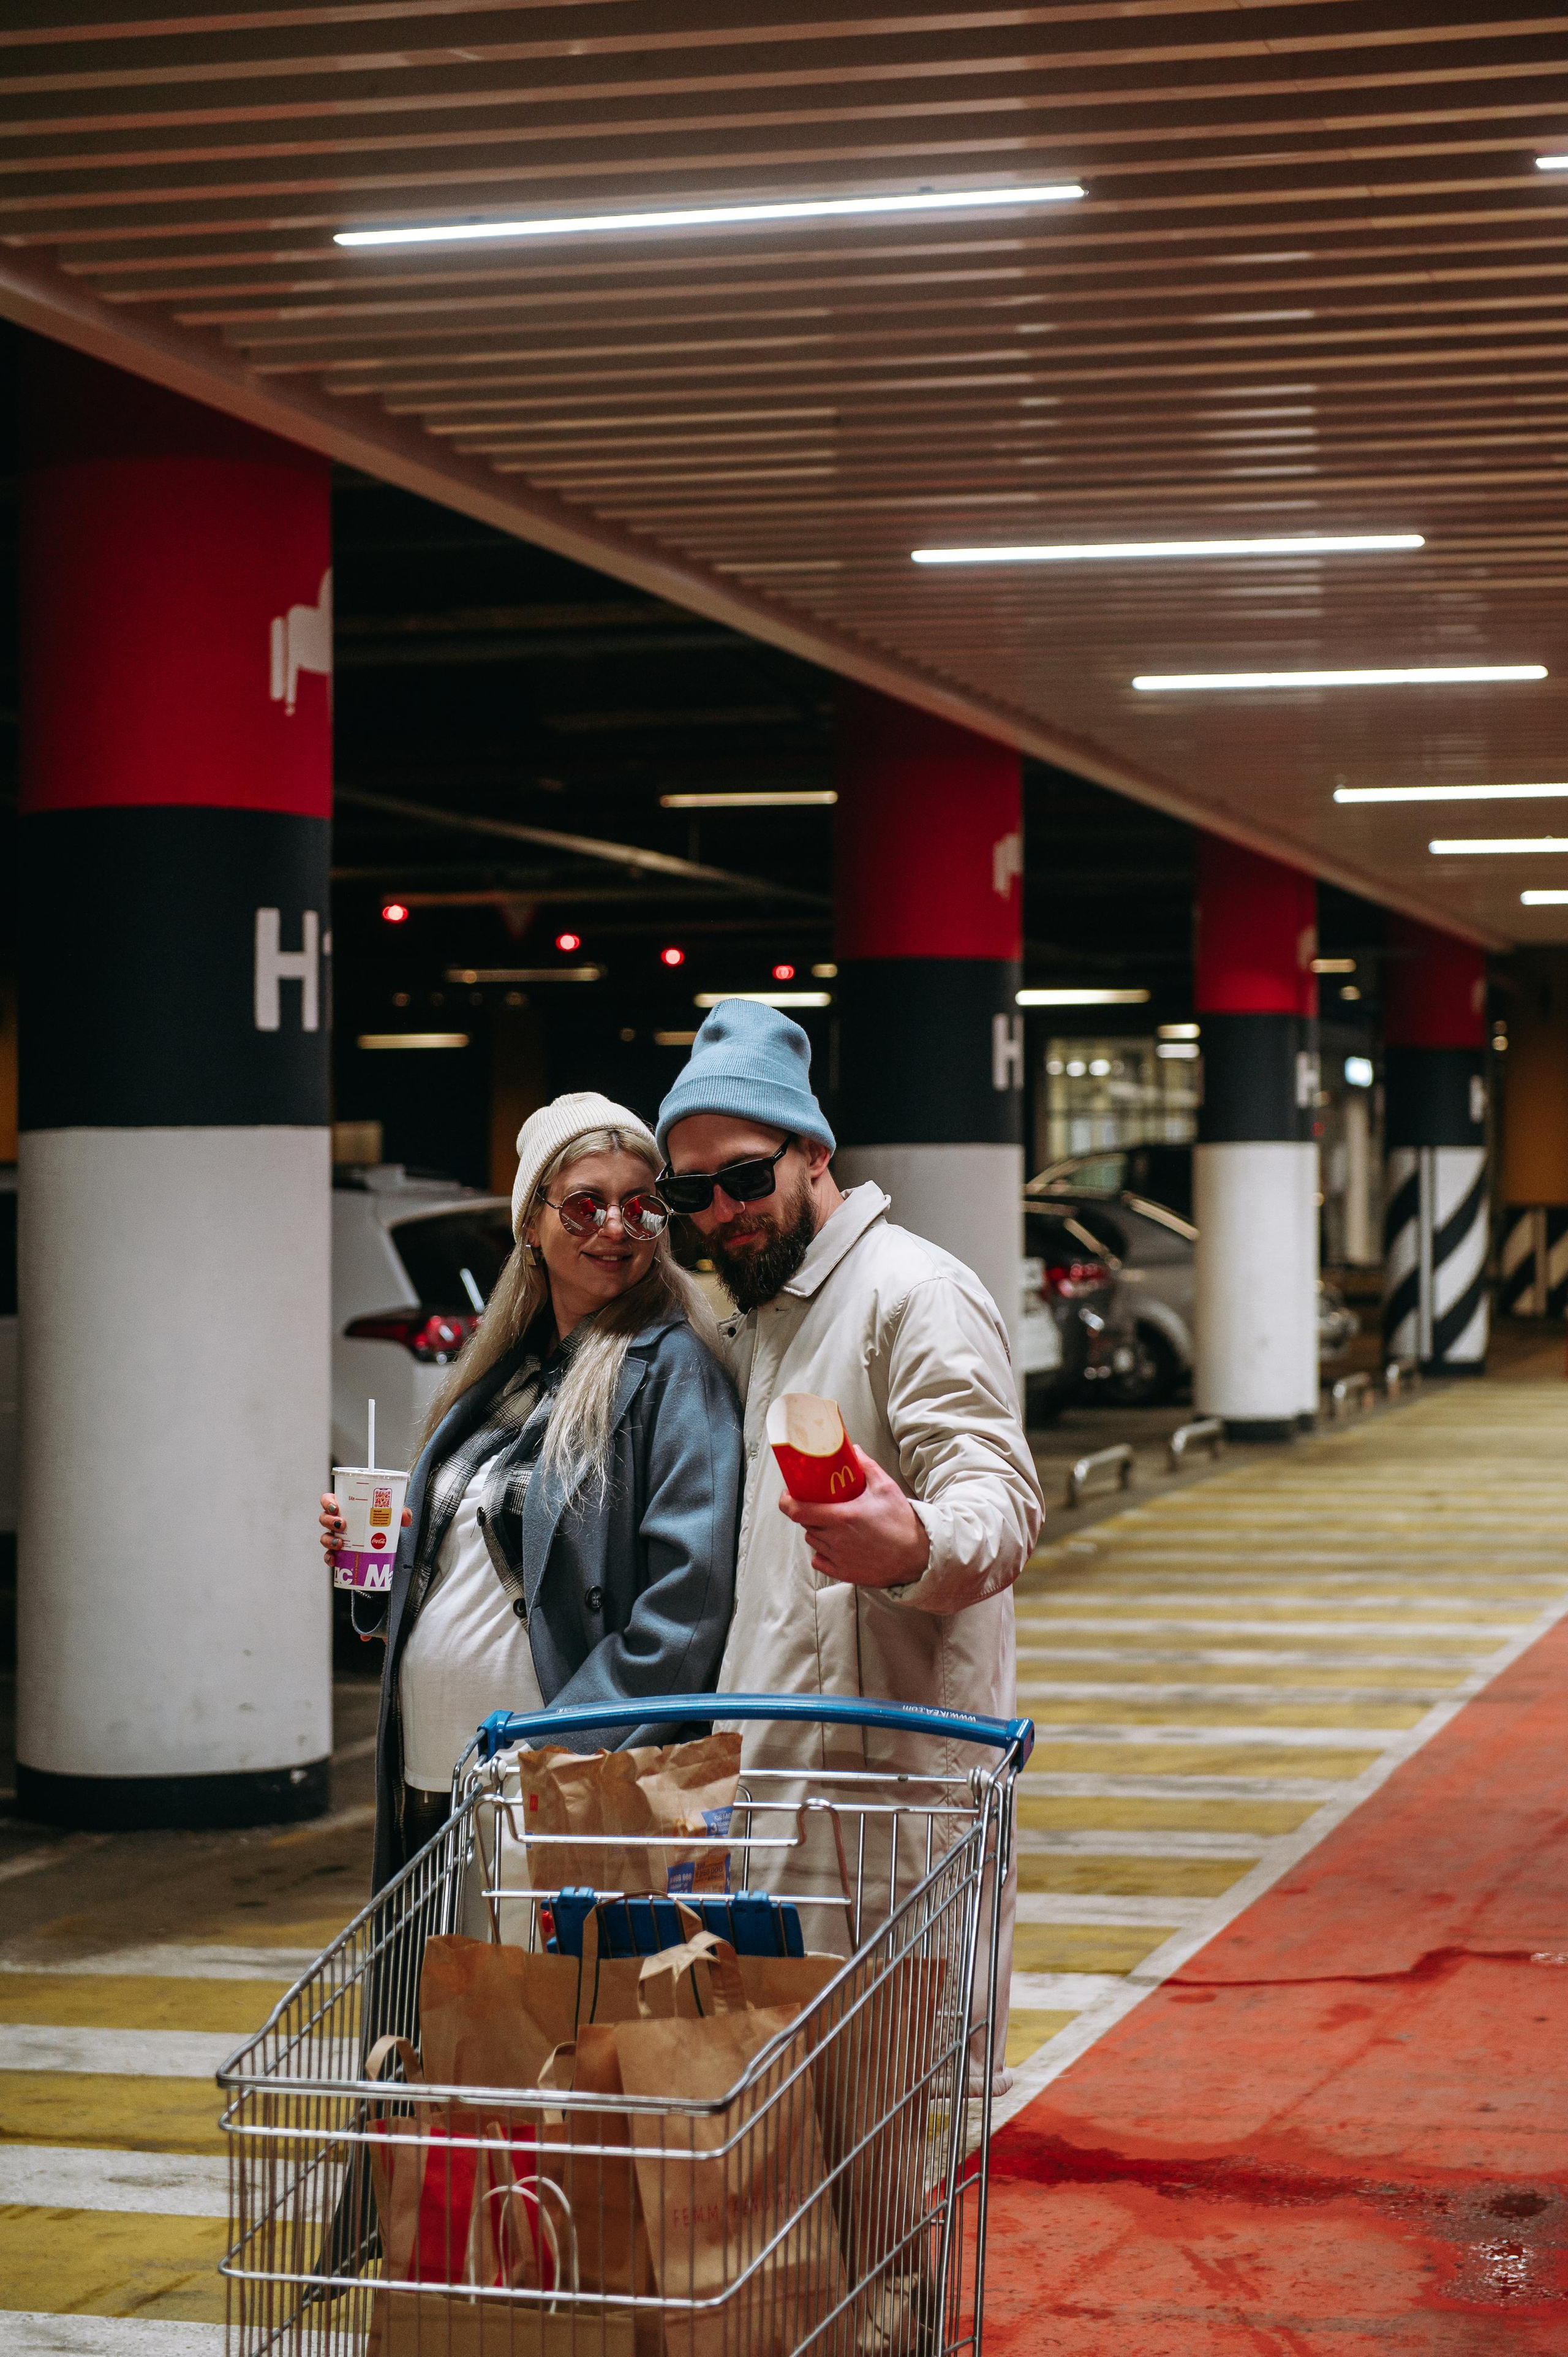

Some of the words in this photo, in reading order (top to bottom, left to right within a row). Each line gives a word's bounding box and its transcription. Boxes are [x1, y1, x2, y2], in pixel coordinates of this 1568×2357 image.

[254, 907, 333, 1032] H
[992, 1013, 1024, 1091] H
[902, 1704, 976, 1722] www.IKEA.com
